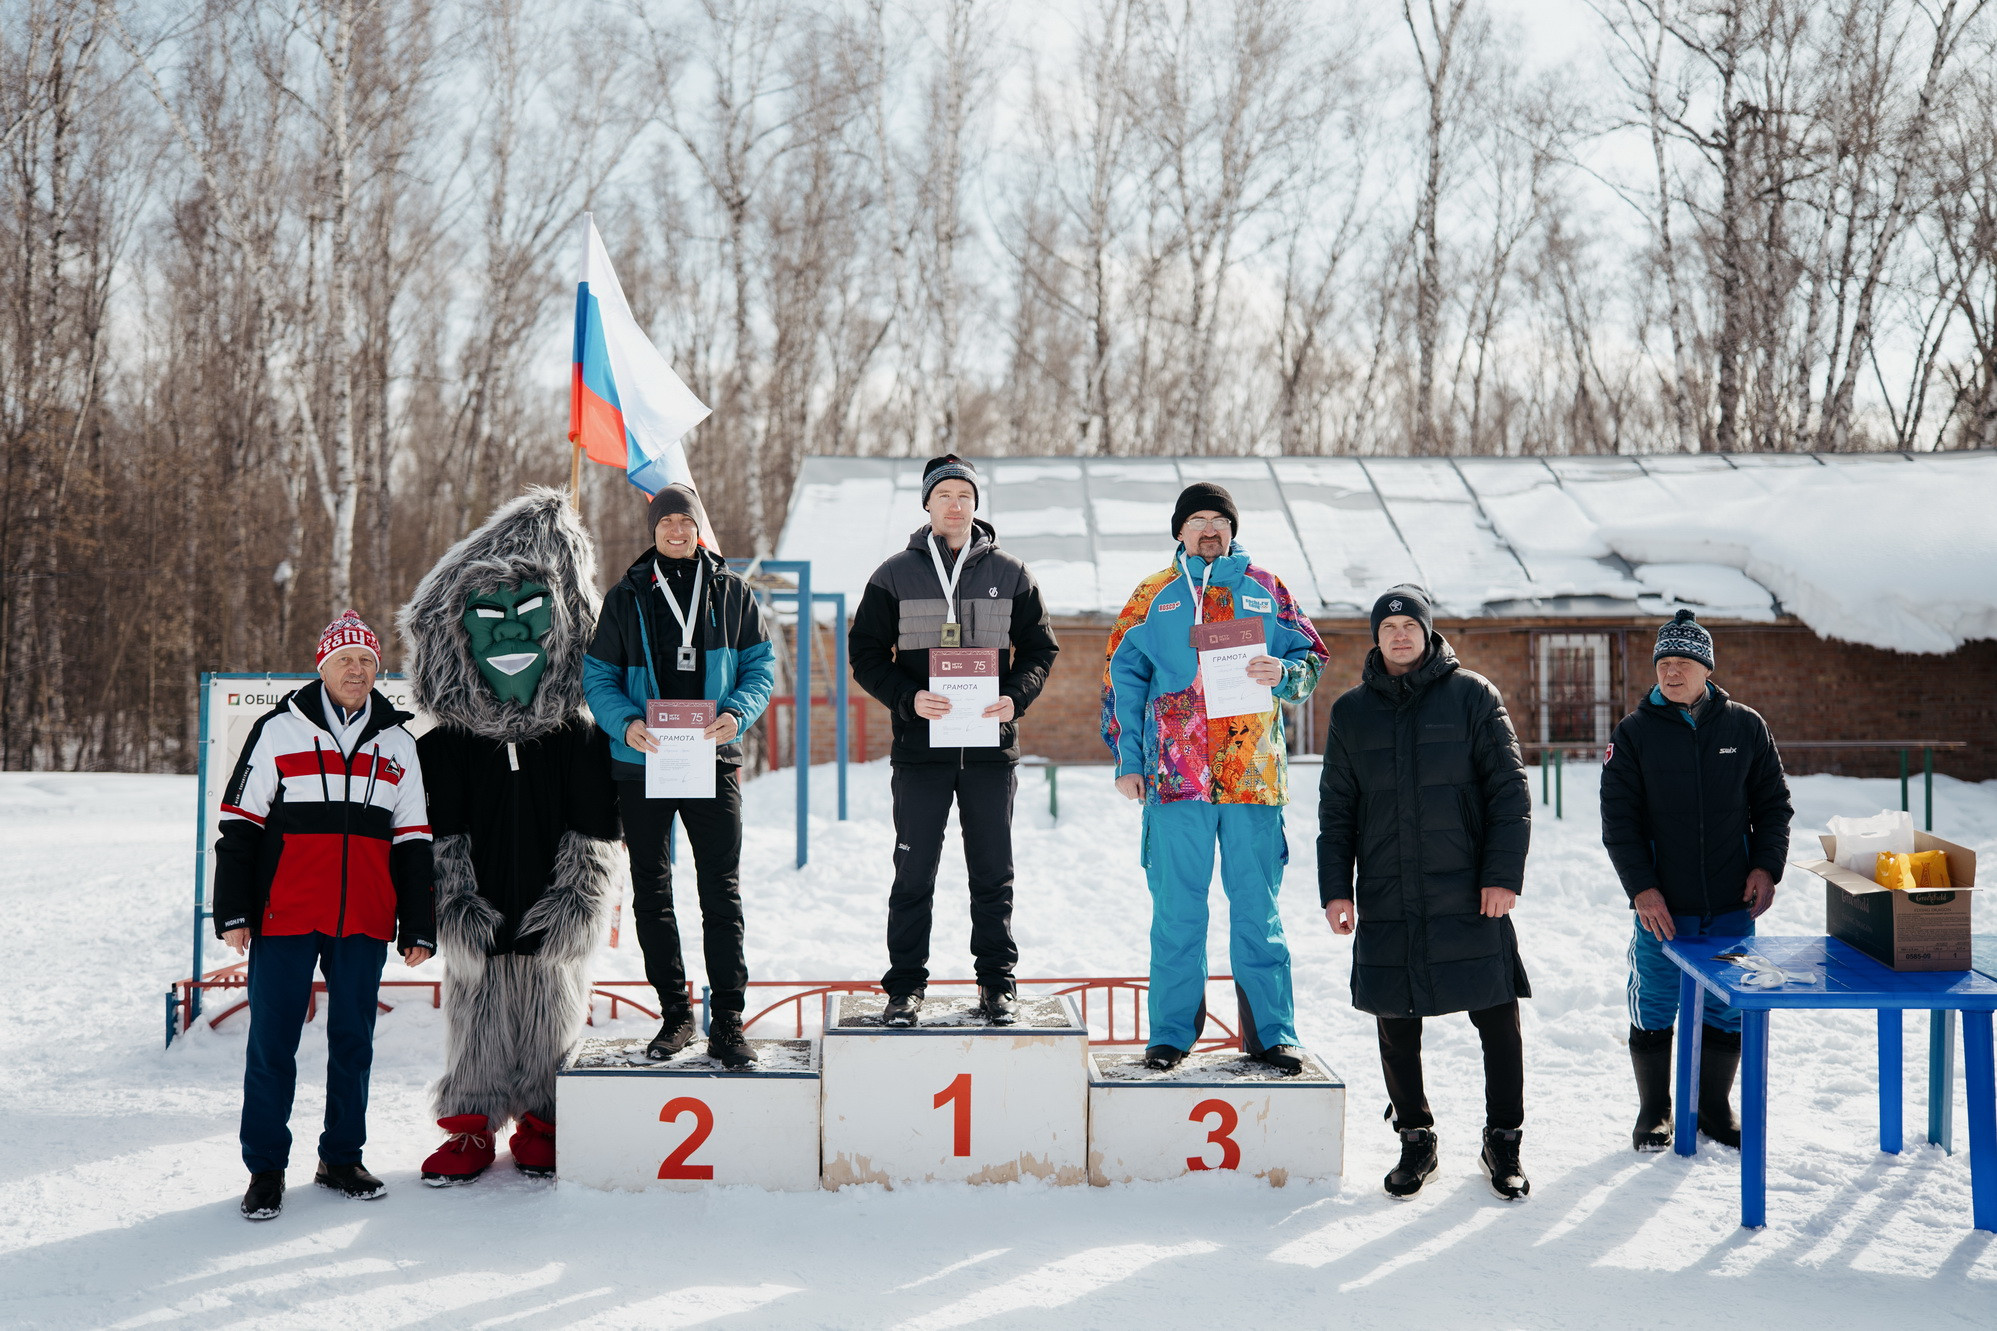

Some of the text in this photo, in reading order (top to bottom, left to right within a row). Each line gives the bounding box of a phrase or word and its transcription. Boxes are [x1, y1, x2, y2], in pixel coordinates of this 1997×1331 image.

[1240, 630, 1252, 640] 75
[1212, 653, 1247, 662] ГРАМОТА
[973, 661, 986, 670] 75
[245, 694, 279, 705] ОБЩ
[690, 712, 704, 722] 75
[934, 1073, 971, 1156] 1
[658, 1097, 714, 1179] 2
[1187, 1099, 1241, 1171] 3
